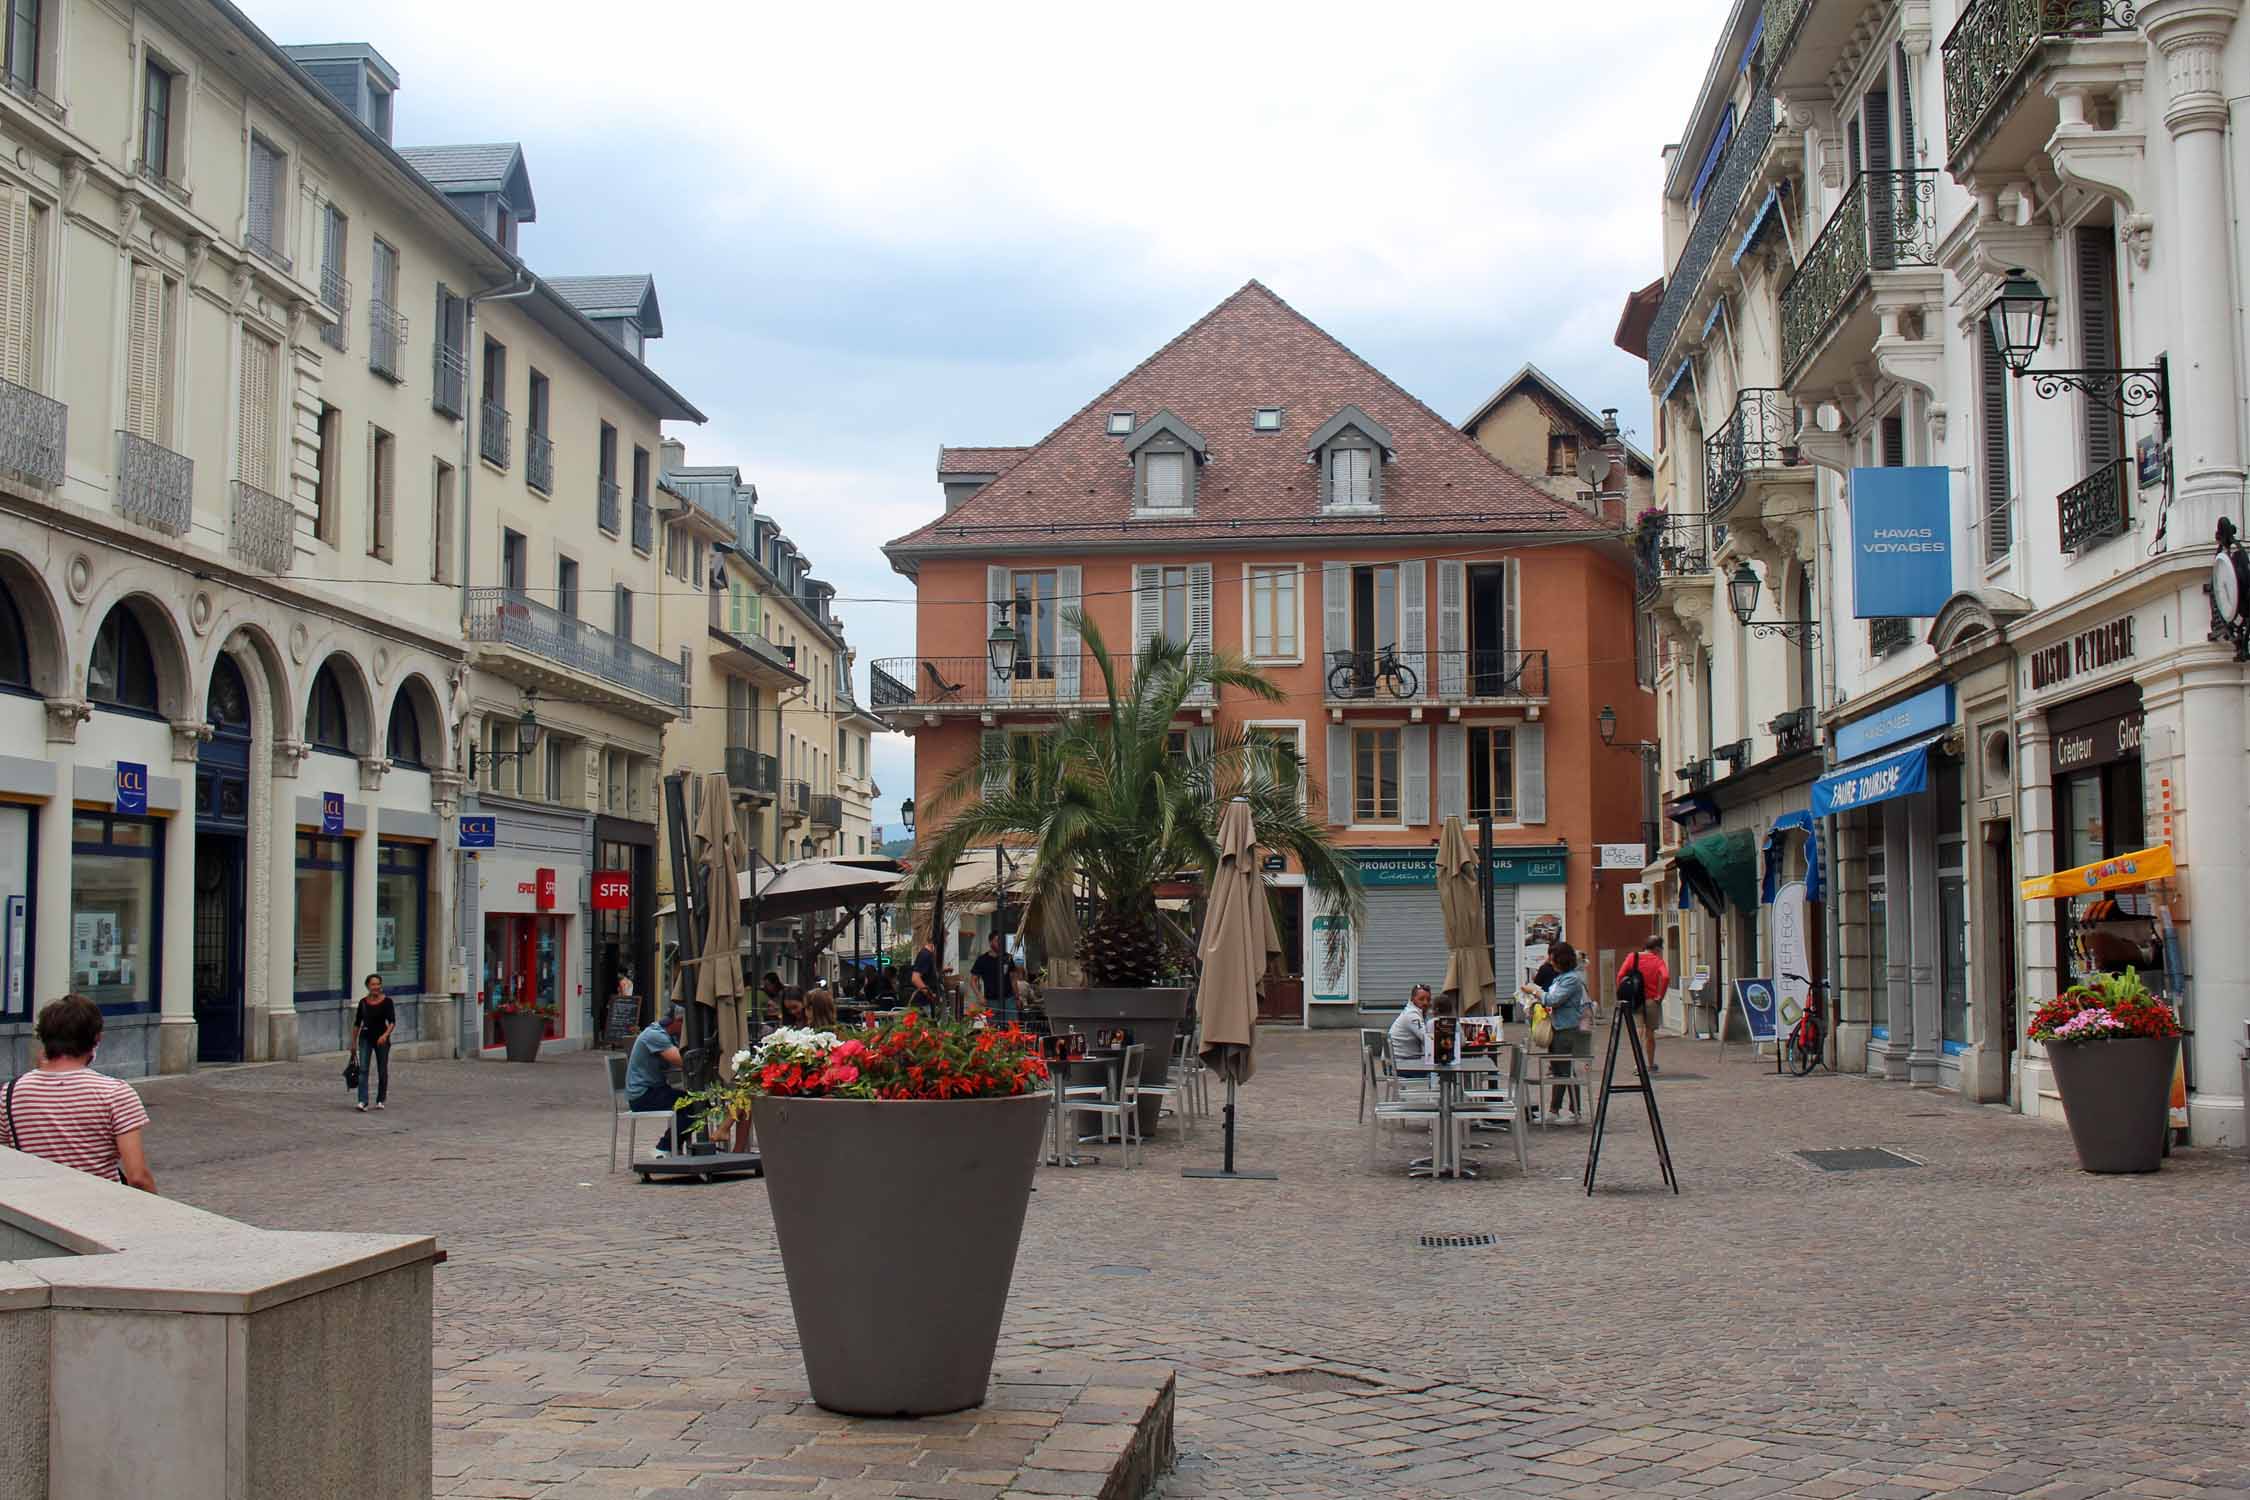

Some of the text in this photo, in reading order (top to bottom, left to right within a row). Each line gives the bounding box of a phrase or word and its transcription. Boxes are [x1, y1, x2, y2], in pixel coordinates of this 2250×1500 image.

[1873, 528, 1932, 538] HAVAS
[1863, 543, 1945, 553] VOYAGES
[2031, 615, 2135, 690] MAISON PEYRAGNE
[2057, 736, 2093, 765] Créateur
[118, 771, 143, 790] LCL
[1829, 766, 1900, 808] FAURE TOURISME
[324, 800, 342, 816] LCL
[462, 822, 491, 833] LCL
[1359, 861, 1426, 870] PROMOTEURS
[600, 883, 629, 897] SFR
